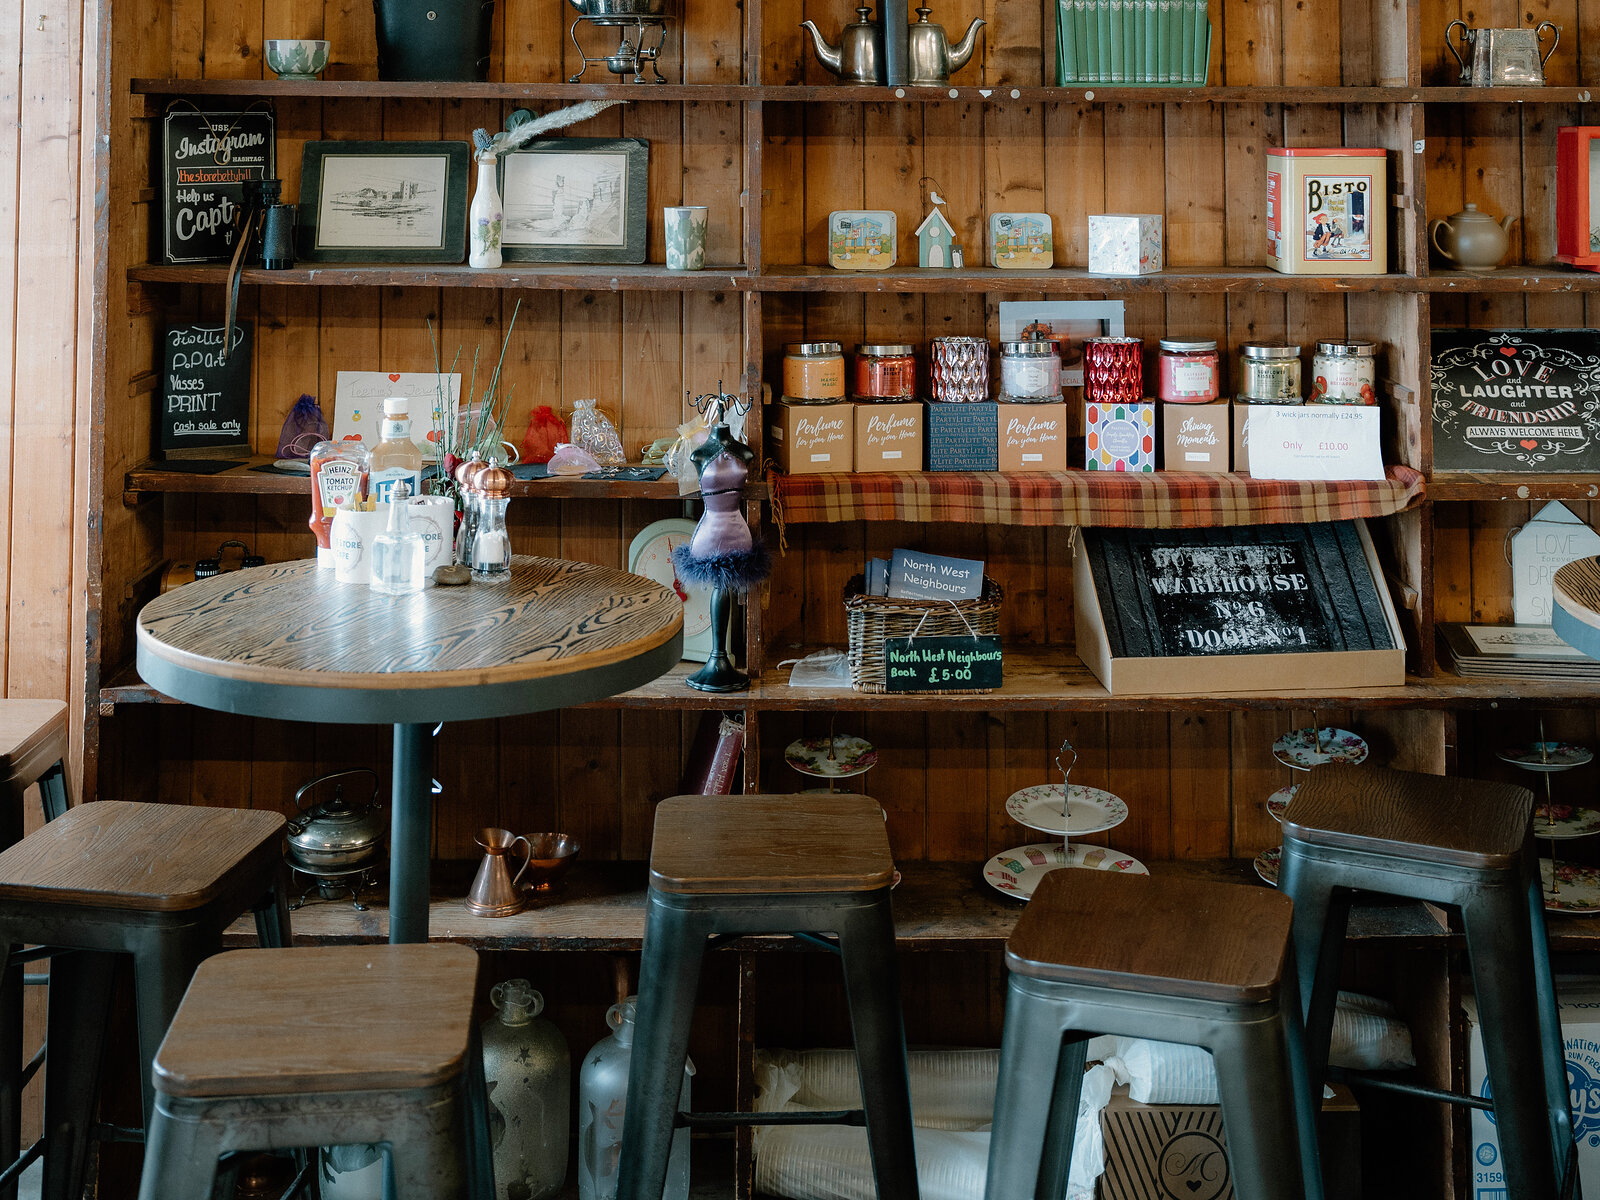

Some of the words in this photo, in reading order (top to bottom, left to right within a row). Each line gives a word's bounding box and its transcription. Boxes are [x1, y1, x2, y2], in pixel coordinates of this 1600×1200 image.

[211, 124, 230, 132] USE
[175, 132, 265, 163] Instagram
[179, 168, 252, 183] thestorebettyhill
[176, 188, 201, 206] Help
[203, 192, 215, 202] us
[1308, 179, 1368, 215] BISTO
[176, 196, 235, 241] Capt
[168, 326, 244, 351] Jewelley
[1471, 358, 1556, 384] LOVE
[170, 374, 205, 391] Vasses
[1506, 376, 1522, 384] and
[1459, 384, 1574, 399] LAUGHTER
[167, 392, 222, 412] PRINT
[1510, 400, 1526, 408] and
[1297, 412, 1310, 420] jars
[1311, 412, 1340, 420] normally
[1340, 412, 1363, 420] £24.95
[1460, 400, 1578, 424] FRIENDSHIP
[173, 420, 195, 432] Cash
[198, 419, 218, 431] sale
[221, 419, 241, 436] only
[796, 415, 845, 436] Perfume
[866, 413, 917, 434] Perfume
[1006, 416, 1058, 437] Perfume
[1180, 417, 1214, 435] Shining
[1469, 427, 1507, 437] ALWAYS
[1508, 428, 1555, 437] WELCOME
[1557, 428, 1579, 437] HERE
[795, 436, 808, 449] for
[827, 432, 845, 443] Home
[867, 434, 879, 446] for
[898, 430, 917, 441] Home
[1006, 436, 1019, 448] for
[1039, 433, 1058, 443] Home
[1282, 441, 1303, 451] Only
[1319, 442, 1349, 451] £10.00
[328, 465, 352, 475] HEINZ
[326, 477, 354, 486] TOMATO
[421, 532, 441, 541] TORE
[1535, 534, 1579, 555] LOVE
[903, 557, 937, 574] North
[940, 564, 970, 579] West
[1528, 565, 1560, 585] DRE
[903, 572, 967, 594] Neighbours
[1151, 573, 1309, 595] WAREHOUSE
[1248, 601, 1266, 618] 6
[1185, 628, 1258, 648] DOOR
[1299, 626, 1308, 645] 1
[890, 650, 921, 663] North
[922, 649, 946, 662] West
[947, 650, 1002, 669] Neighbours
[890, 667, 917, 678] Book
[1568, 1051, 1584, 1061] RUN
